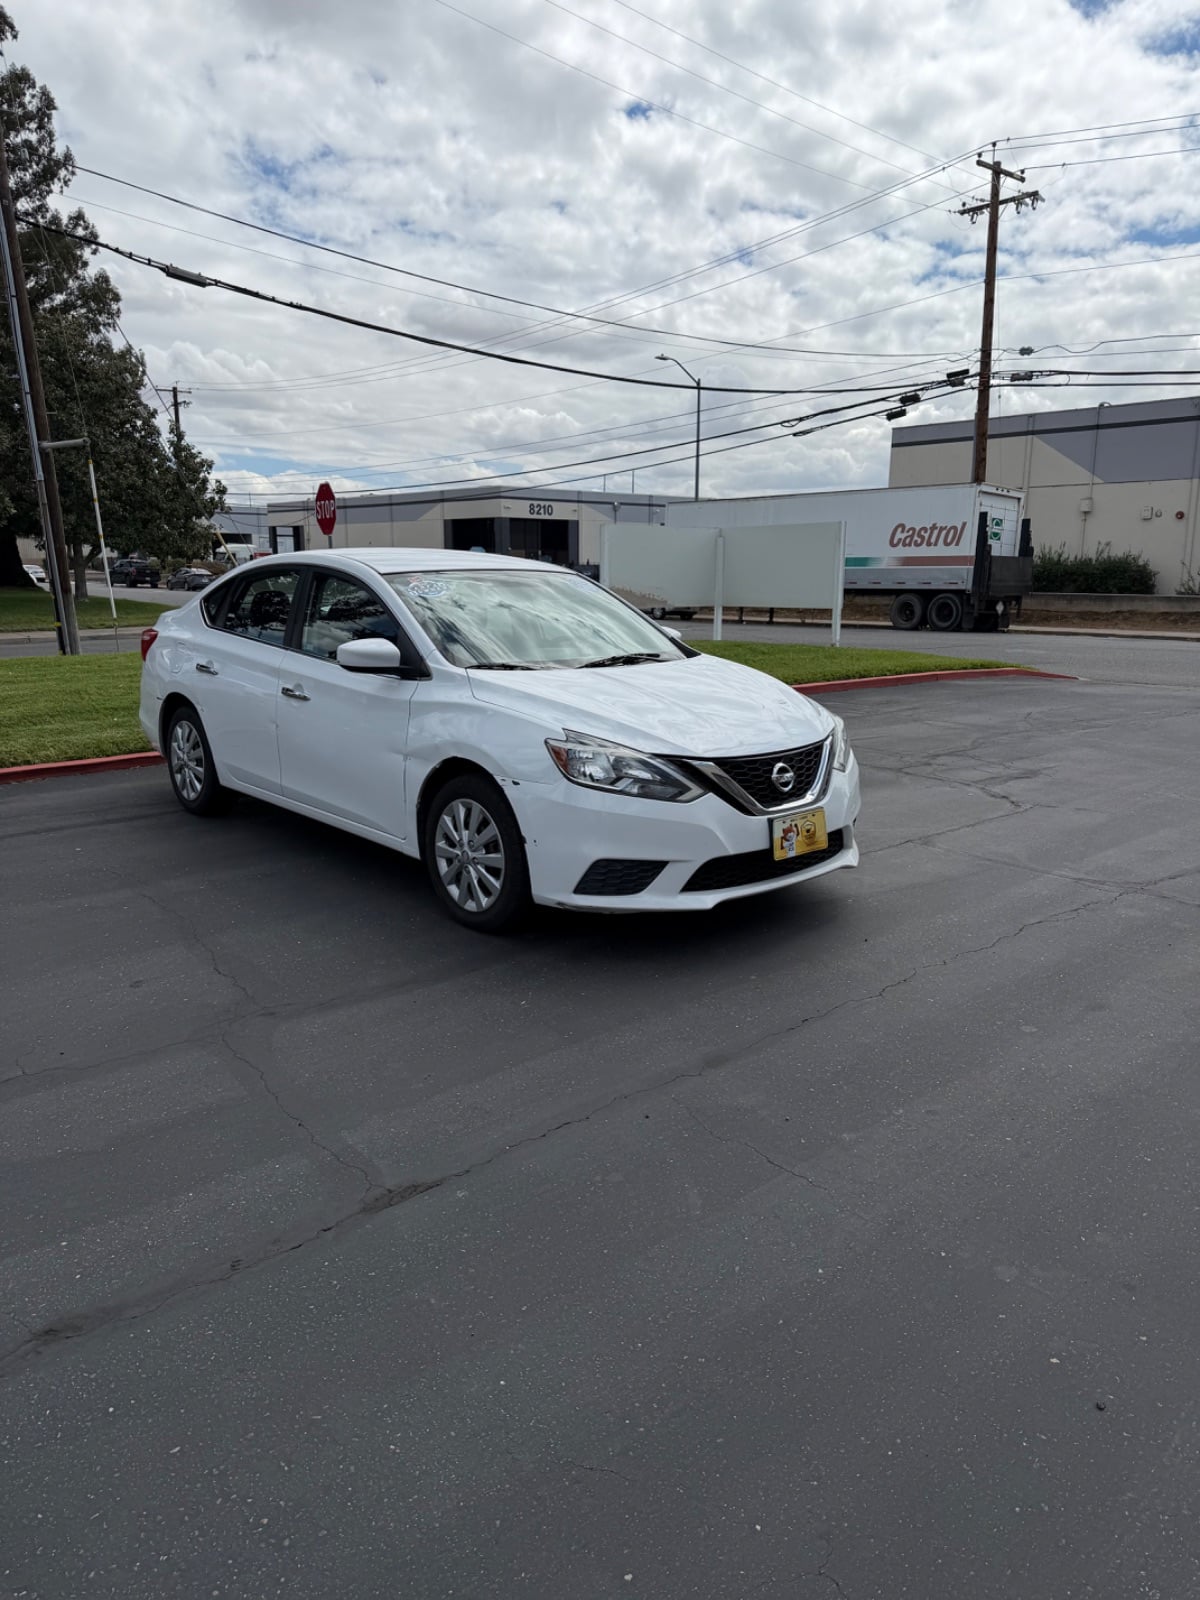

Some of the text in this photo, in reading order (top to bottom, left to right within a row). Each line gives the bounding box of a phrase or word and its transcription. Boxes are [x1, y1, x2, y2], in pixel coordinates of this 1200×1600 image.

[316, 500, 334, 519] STOP
[529, 503, 553, 516] 8210
[889, 521, 967, 547] Castrol
